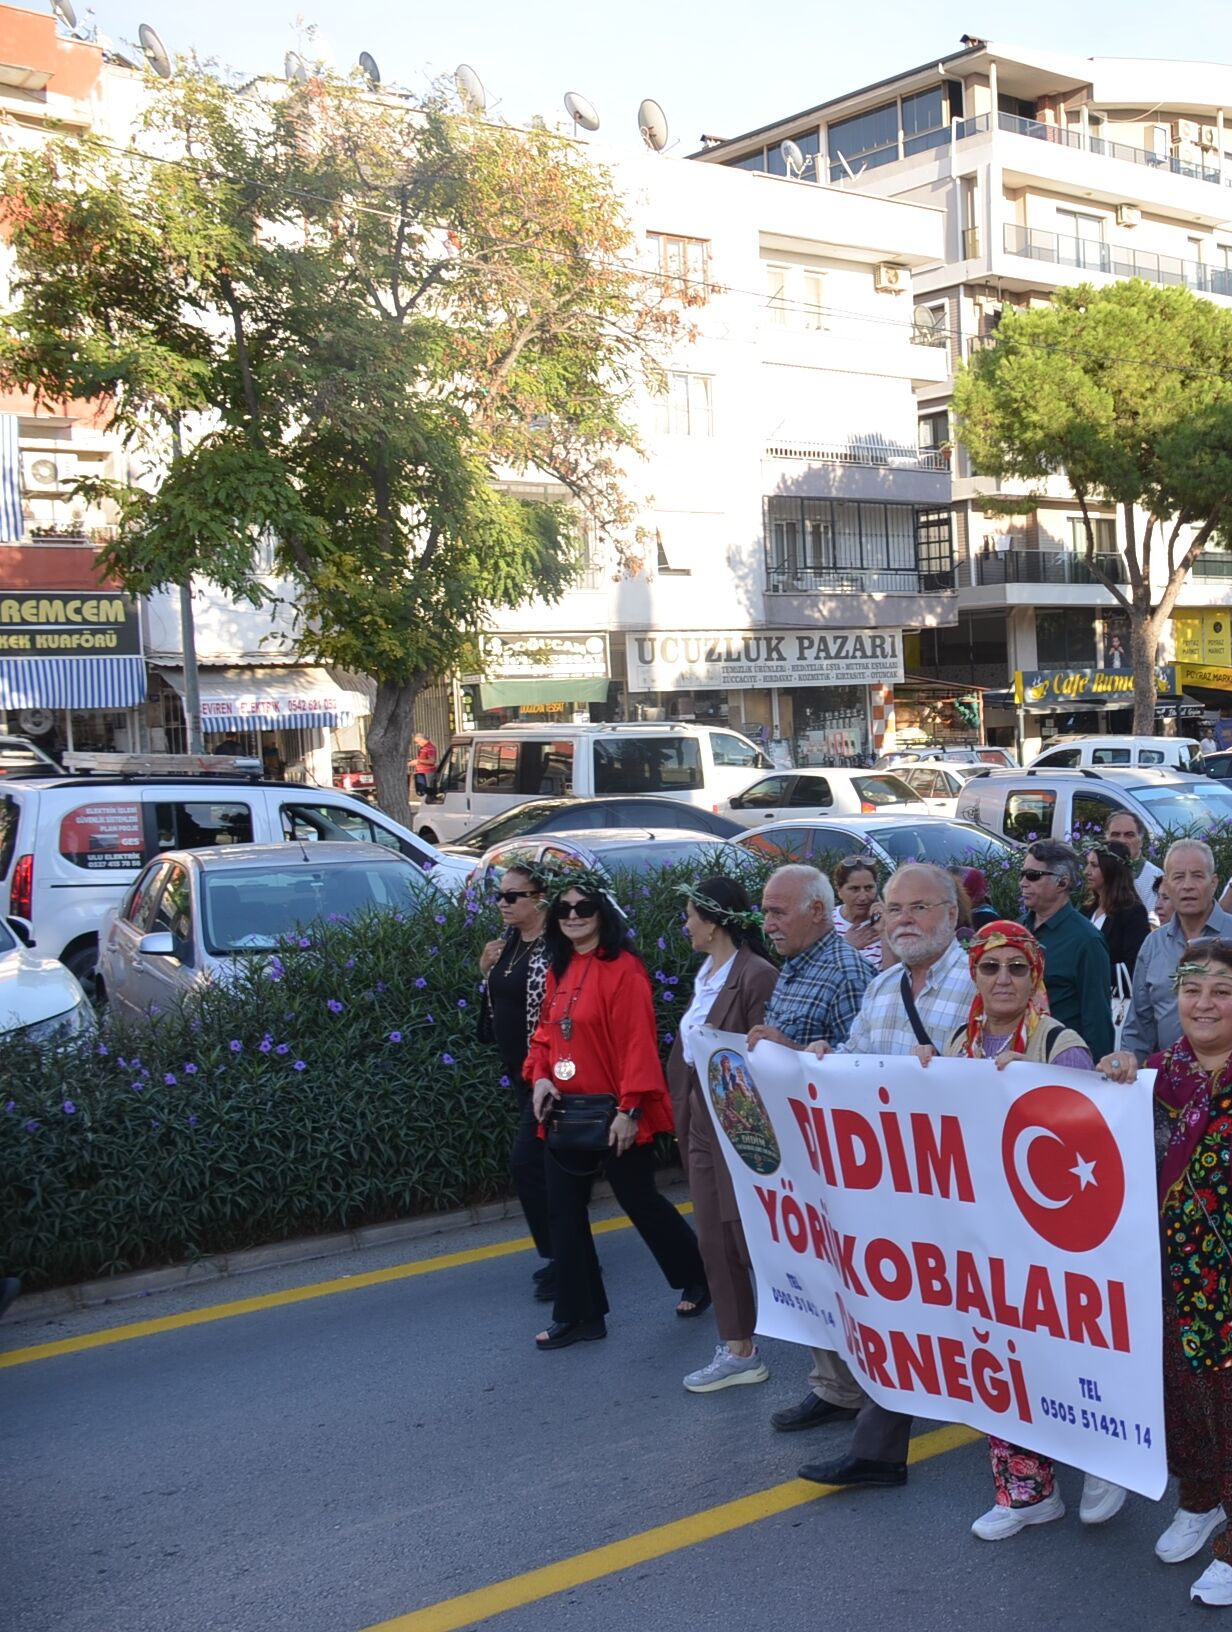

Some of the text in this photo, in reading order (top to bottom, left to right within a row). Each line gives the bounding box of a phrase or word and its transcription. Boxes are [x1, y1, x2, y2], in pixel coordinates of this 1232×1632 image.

[634, 635, 787, 665] UCUZLUK
[795, 634, 899, 661] PAZARI
[1053, 673, 1088, 697] Cafe
[786, 1082, 977, 1204] DİDİM
[834, 1291, 1033, 1425] DERNEĞİ
[1078, 1376, 1102, 1402] TEL
[1040, 1396, 1077, 1425] 0505
[1134, 1423, 1152, 1449] 14
